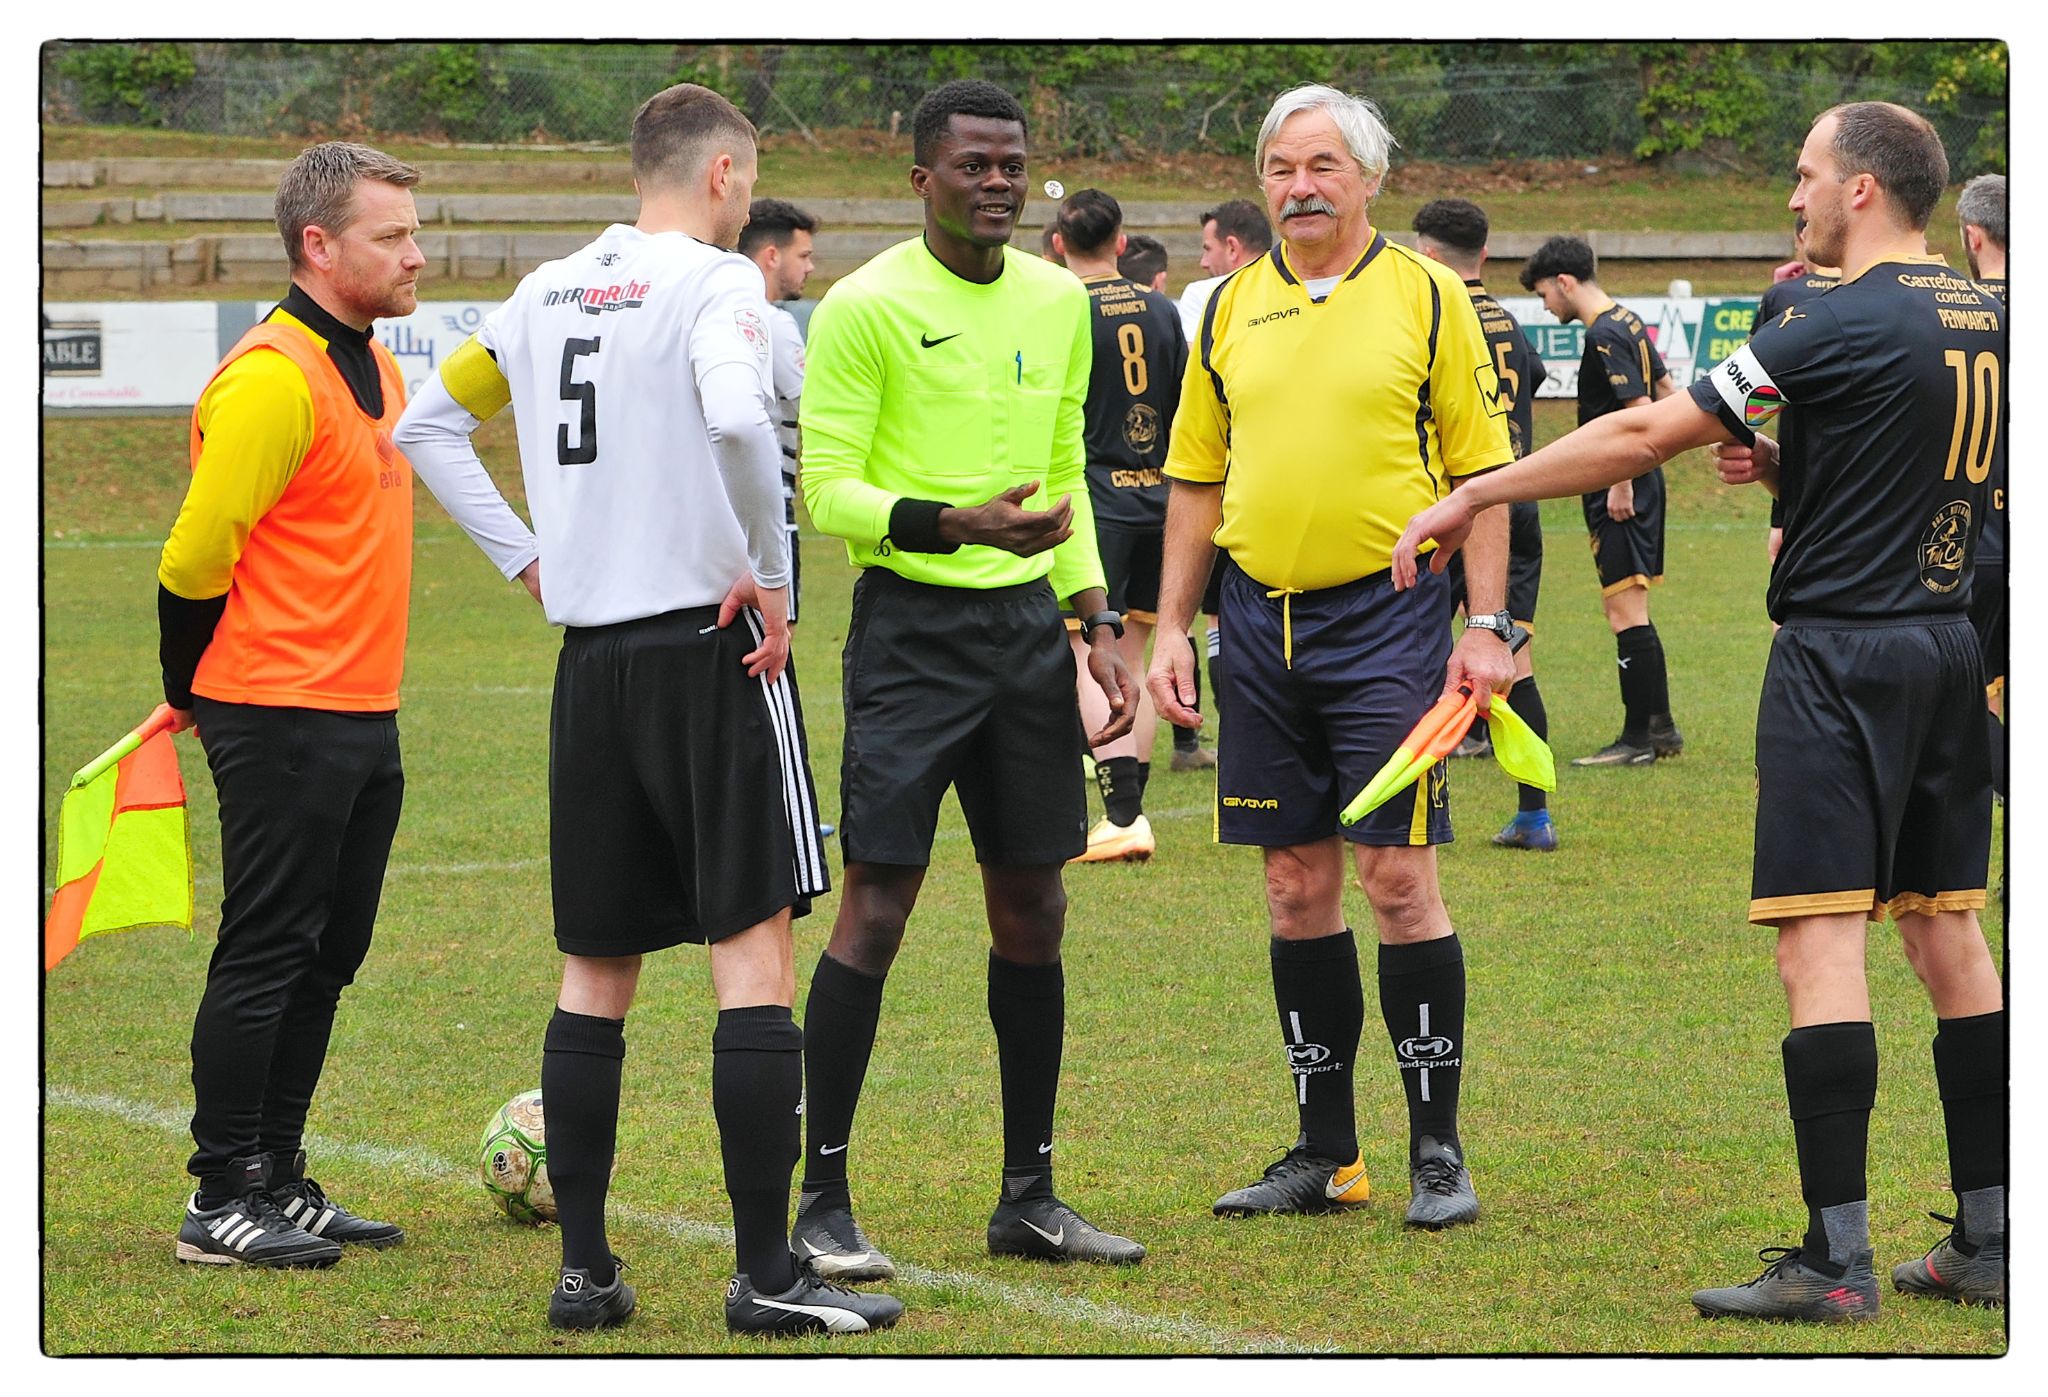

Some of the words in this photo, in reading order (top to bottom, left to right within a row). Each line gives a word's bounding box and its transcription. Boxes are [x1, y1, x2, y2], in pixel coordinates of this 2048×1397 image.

[1898, 272, 1972, 291] Carrefour
[1935, 291, 1982, 305] contact
[1247, 307, 1300, 327] GIVOVA
[1714, 310, 1754, 332] CRE
[44, 341, 97, 364] ABLE
[1117, 322, 1149, 397] 8
[1494, 341, 1519, 412] 5
[557, 336, 601, 466] 5
[1943, 349, 2000, 484] 10
[1223, 797, 1278, 809] GIVOVA
